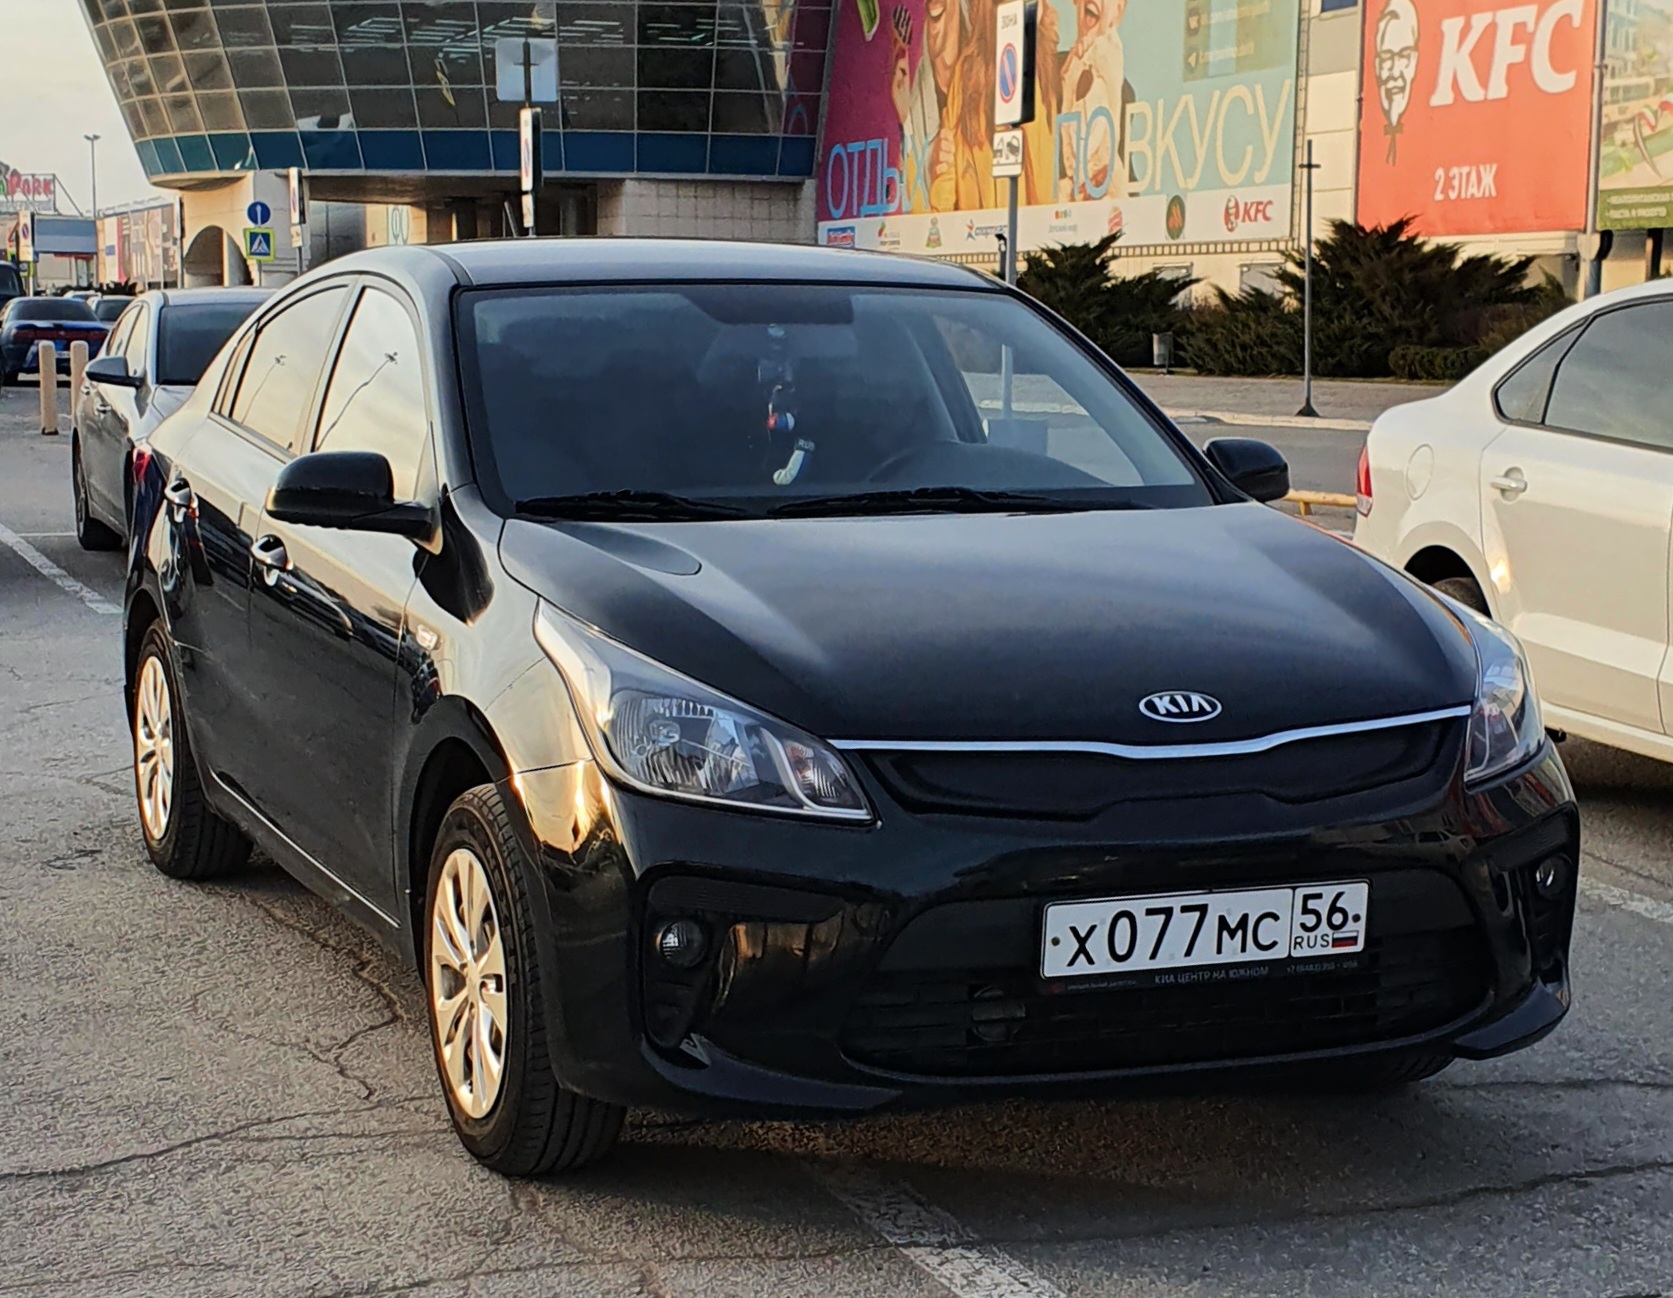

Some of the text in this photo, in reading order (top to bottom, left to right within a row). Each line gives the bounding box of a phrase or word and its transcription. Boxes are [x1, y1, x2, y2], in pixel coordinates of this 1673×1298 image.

[1429, 0, 1585, 107] KFC
[827, 79, 1292, 219] ОТДЫХ ПО ВКУСУ
[1434, 163, 1498, 201] 2 ЭТАЖ
[1241, 200, 1274, 223] KFC
[1150, 694, 1213, 715] KIA
[1299, 891, 1349, 933] 56
[1293, 933, 1330, 950] RUS
